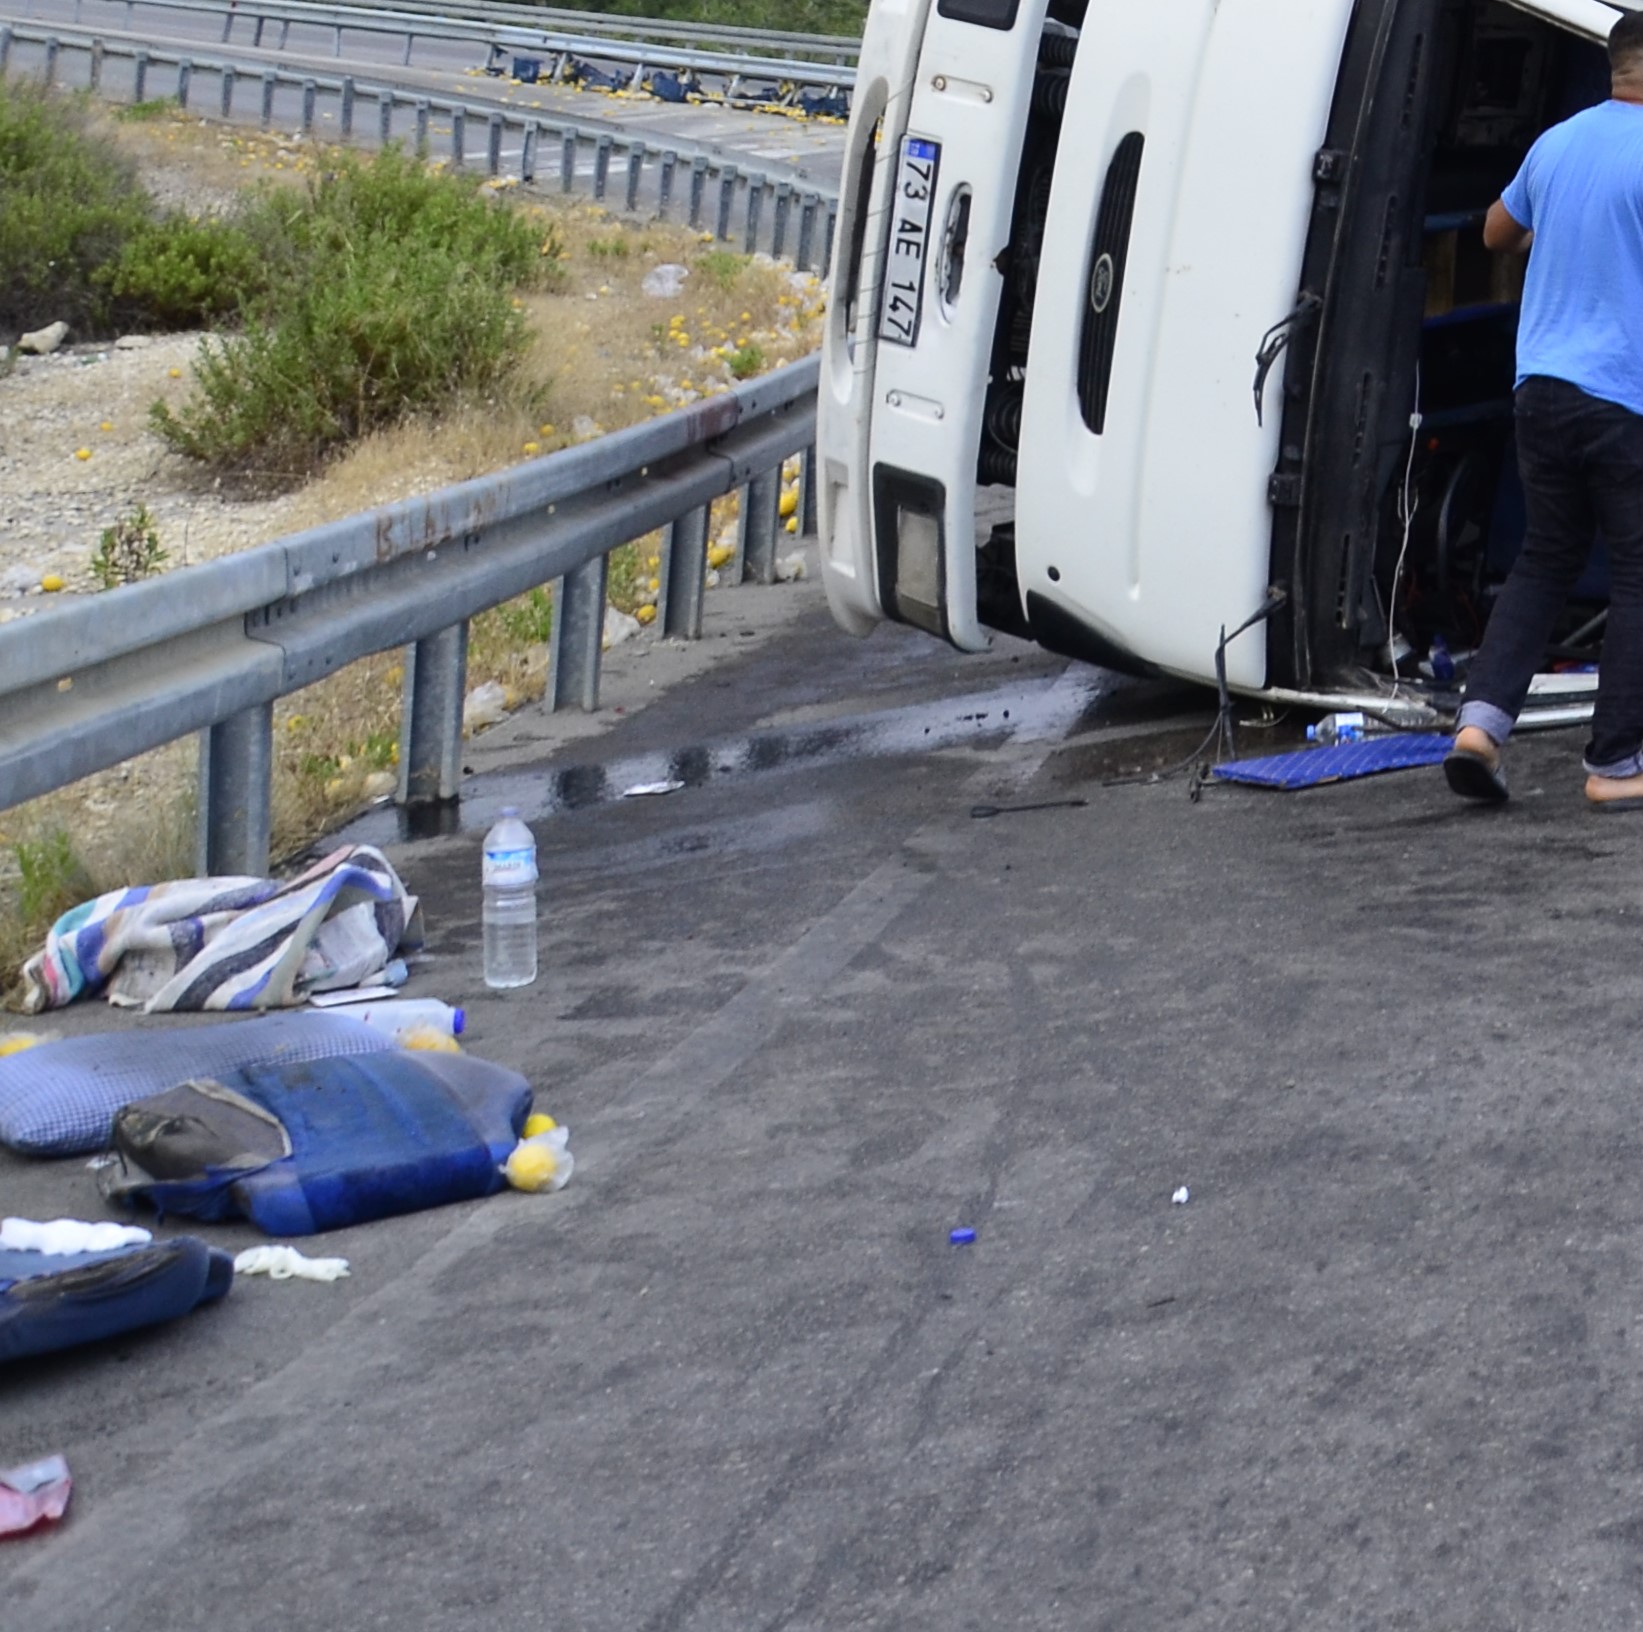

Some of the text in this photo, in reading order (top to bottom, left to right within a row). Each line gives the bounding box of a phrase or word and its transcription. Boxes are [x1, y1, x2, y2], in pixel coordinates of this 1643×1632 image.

[904, 162, 931, 201] 73
[895, 218, 923, 260] AE
[888, 280, 917, 338] 147
